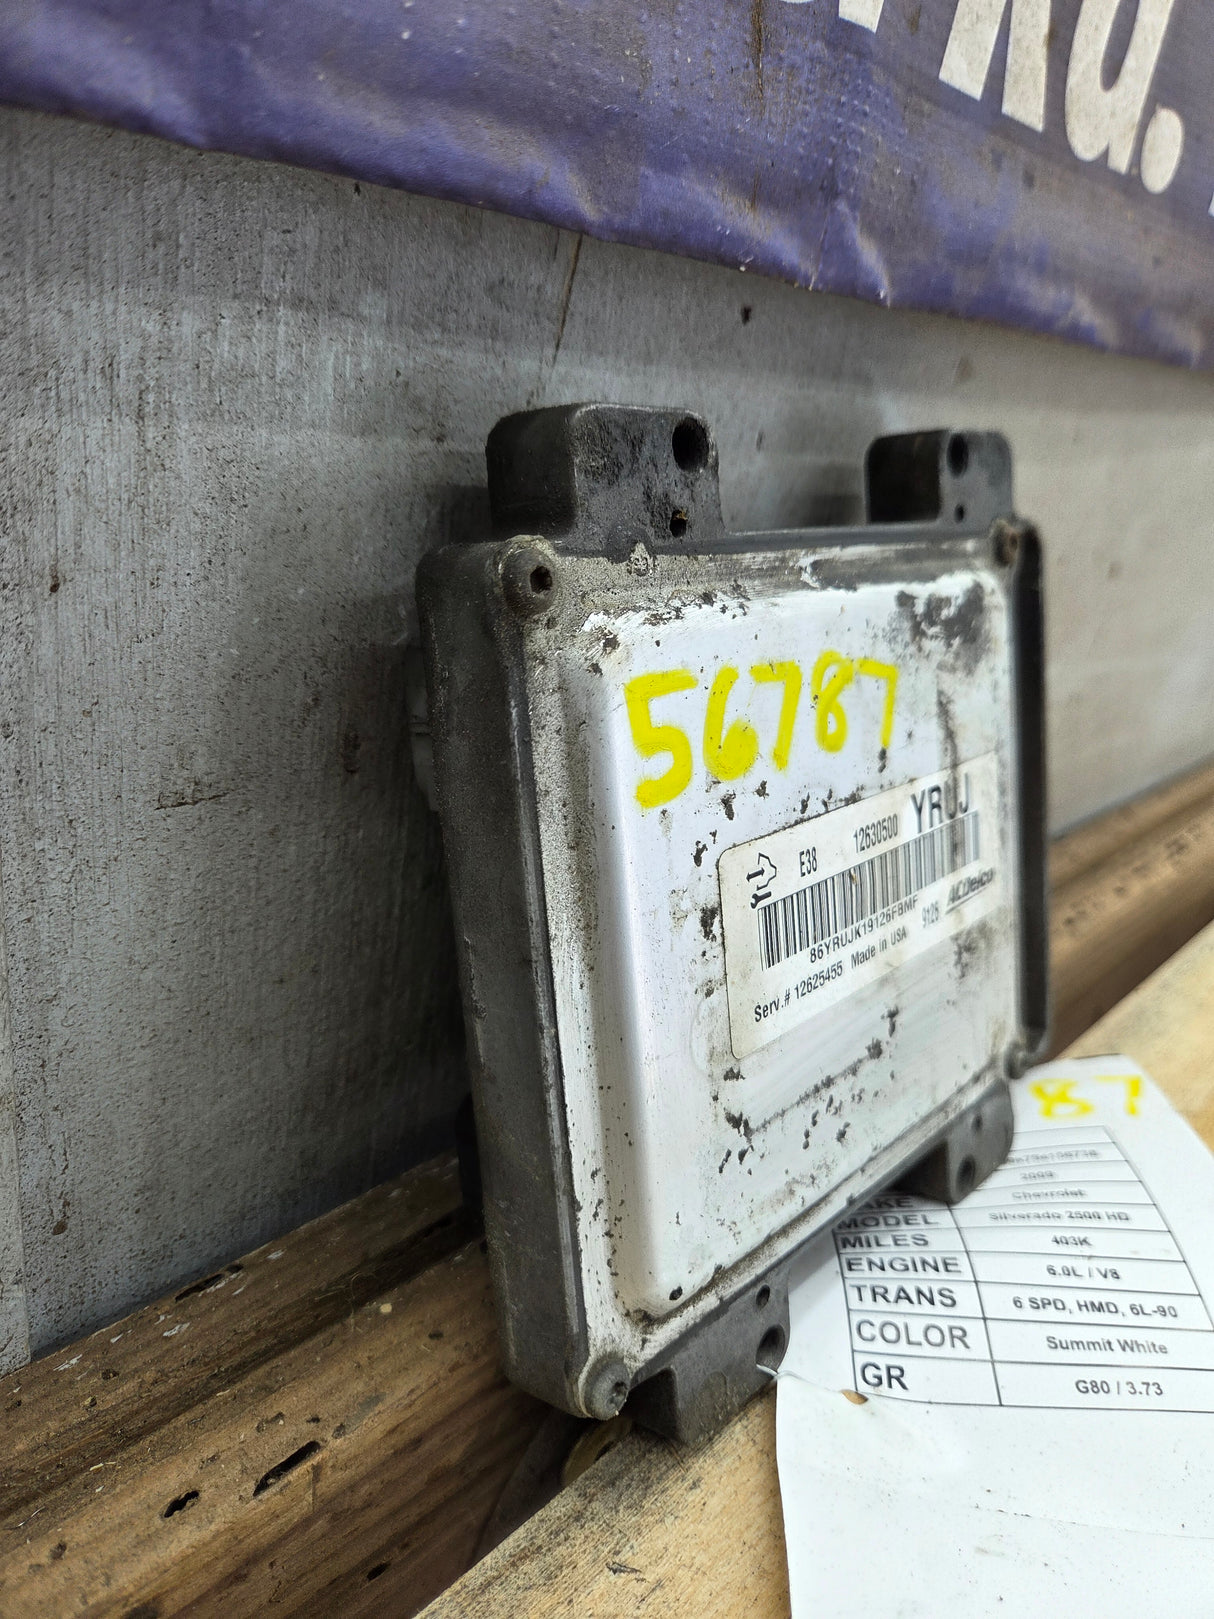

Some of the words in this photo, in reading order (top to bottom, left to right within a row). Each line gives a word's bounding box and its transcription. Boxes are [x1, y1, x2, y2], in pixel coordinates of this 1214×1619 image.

[623, 650, 898, 809] 56787
[799, 846, 818, 878] E38
[853, 813, 899, 853] 12630500
[909, 773, 971, 834] YRUJ
[794, 960, 843, 1000] 12625455
[851, 943, 876, 969] Made
[878, 937, 888, 950] in
[890, 926, 908, 946] USA
[859, 1195, 915, 1210] AKE
[836, 1213, 940, 1231] MODEL
[988, 1210, 1063, 1222] Silverado
[1065, 1210, 1104, 1221] 2500
[1105, 1211, 1132, 1222] HD
[840, 1232, 930, 1250] MILES
[1050, 1235, 1093, 1247] 403K
[845, 1256, 963, 1274] ENGINE
[1046, 1264, 1083, 1278] 6.0L
[1097, 1266, 1122, 1280] V8
[849, 1284, 958, 1308] TRANS
[1012, 1296, 1024, 1309] 6
[1028, 1297, 1073, 1315] SPD,
[1076, 1300, 1126, 1318] HMD,
[1129, 1303, 1179, 1319] 6L-90
[855, 1318, 971, 1350] COLOR
[1046, 1335, 1114, 1353] Summit
[1117, 1338, 1169, 1355] White
[860, 1361, 910, 1391] GR
[1074, 1379, 1111, 1395] G80
[1125, 1381, 1164, 1396] 3.73
